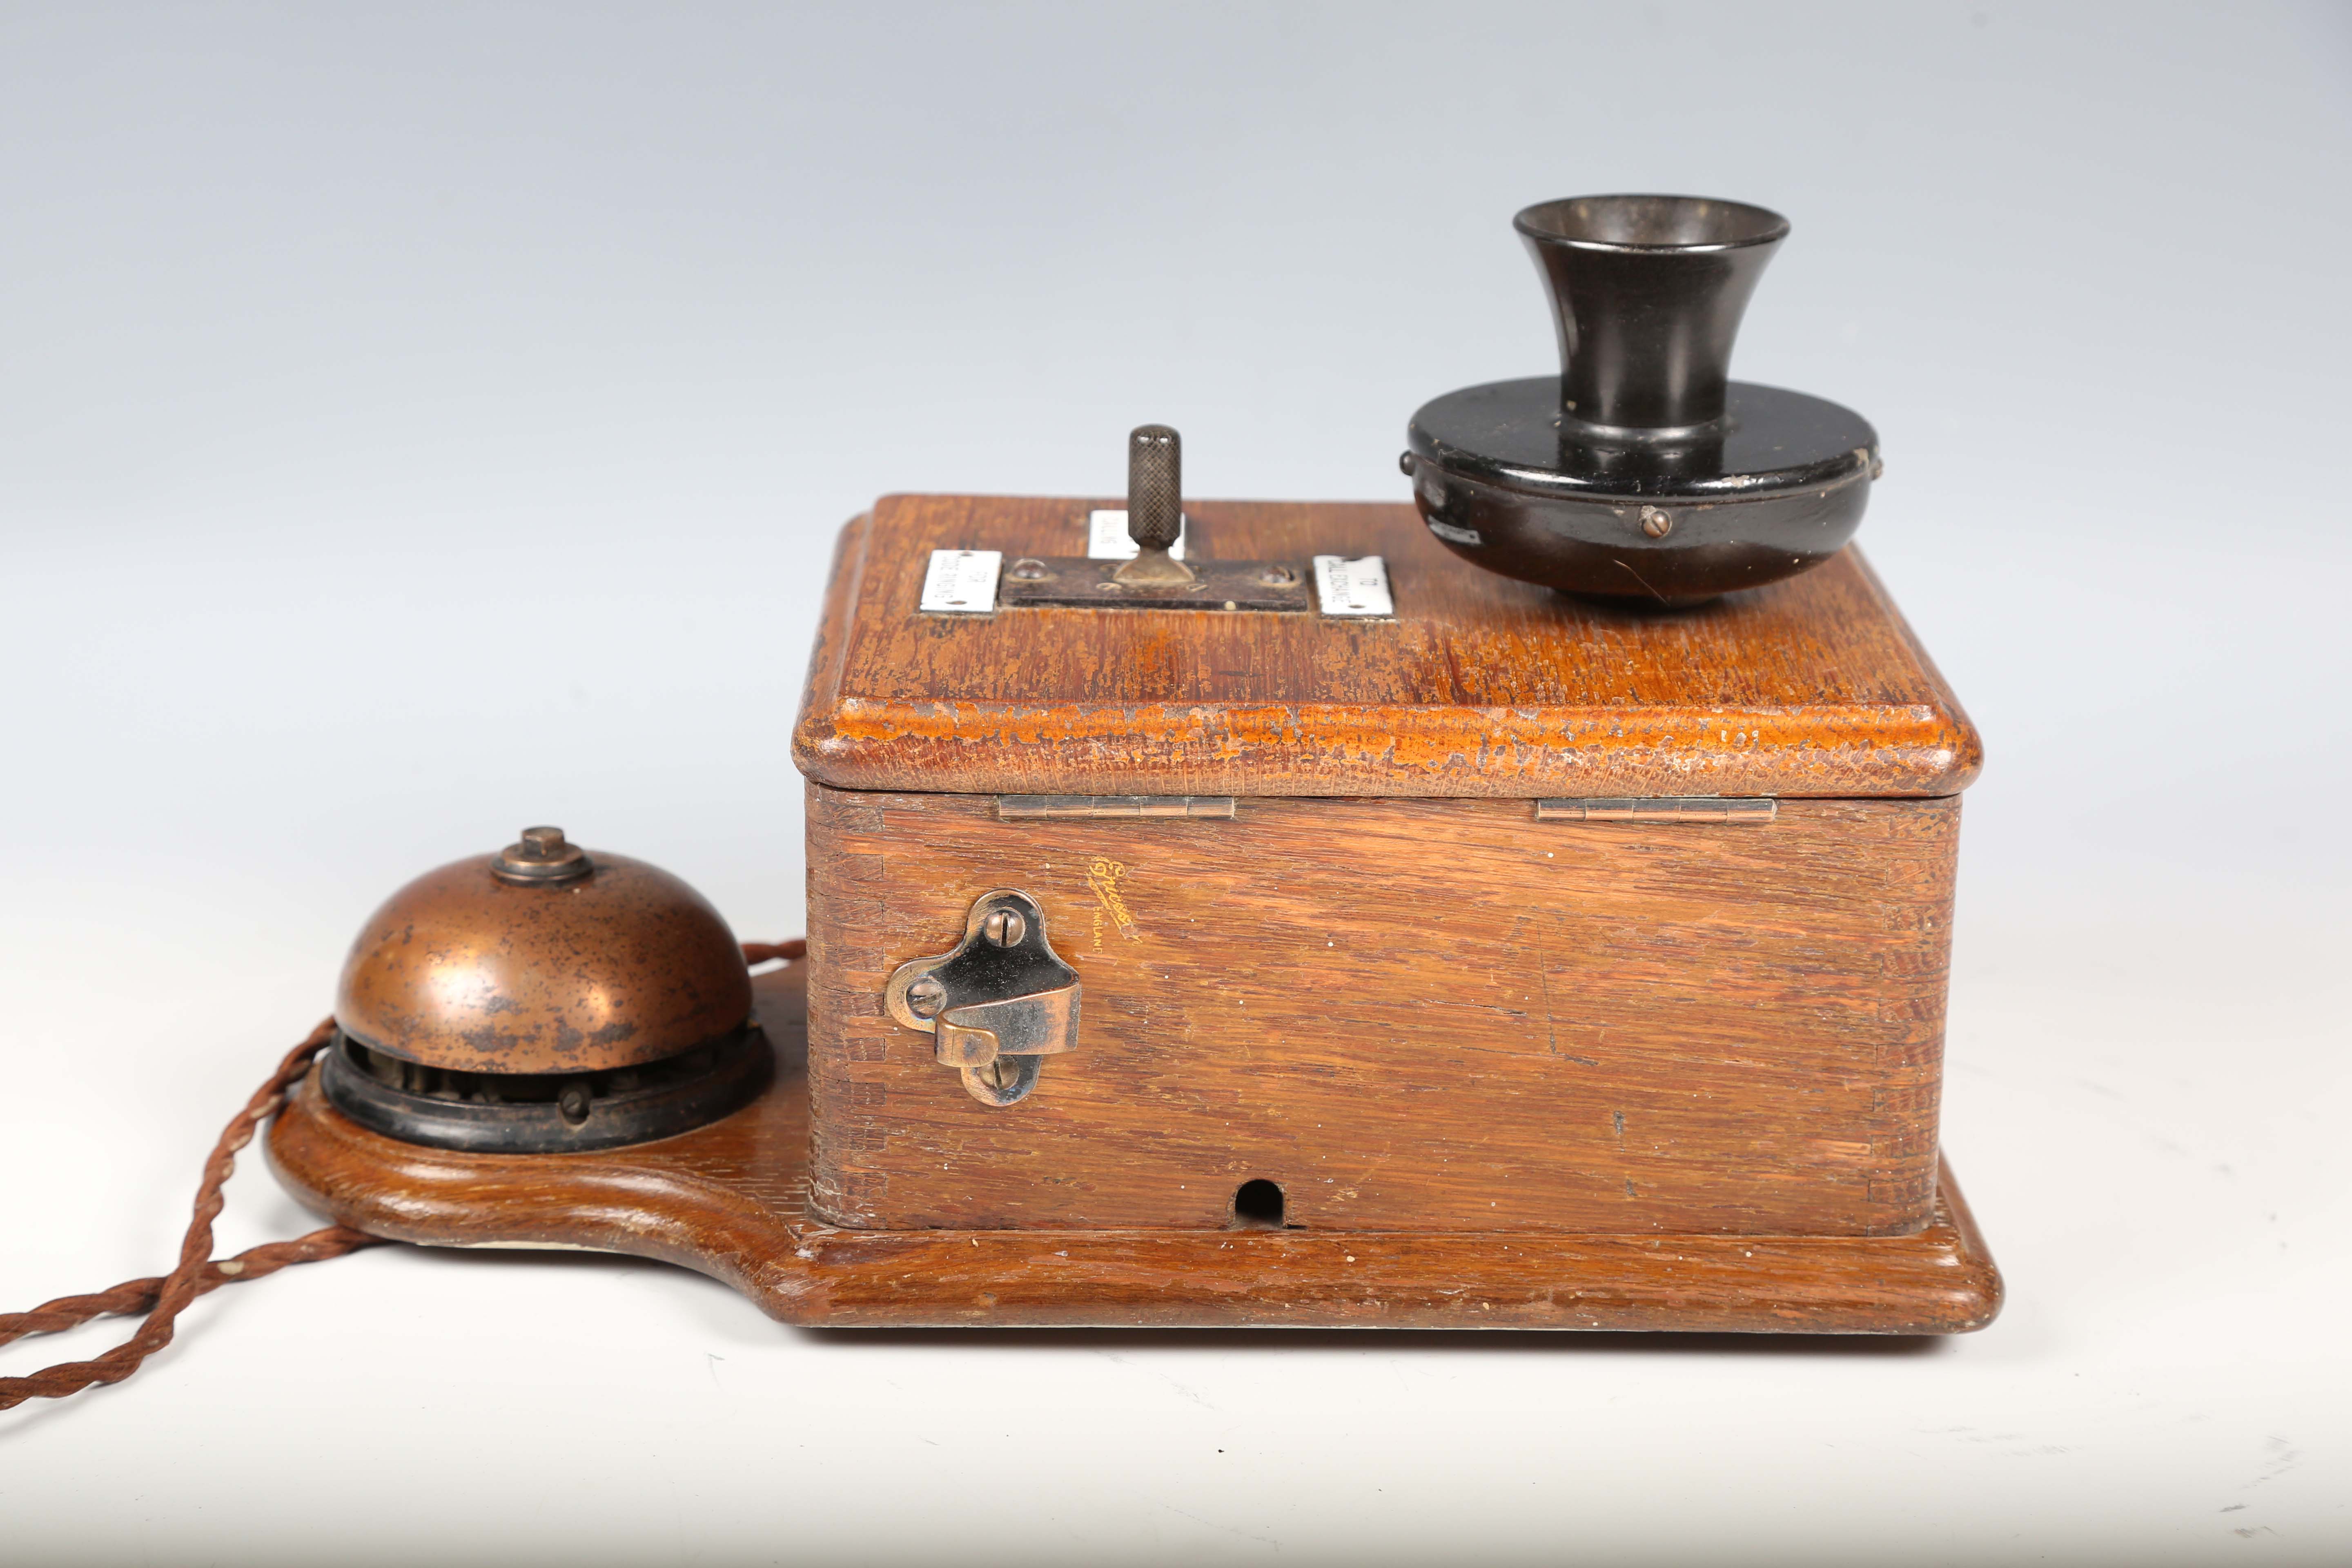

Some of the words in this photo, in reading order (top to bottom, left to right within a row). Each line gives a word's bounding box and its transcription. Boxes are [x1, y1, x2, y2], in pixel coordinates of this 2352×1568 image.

[940, 555, 961, 570] CODE
[935, 573, 958, 598] RINGING
[968, 571, 988, 583] FOR
[1359, 577, 1379, 586] TO
[1329, 574, 1351, 603] EXCHANGE
[1088, 856, 1143, 946] Ericssn
